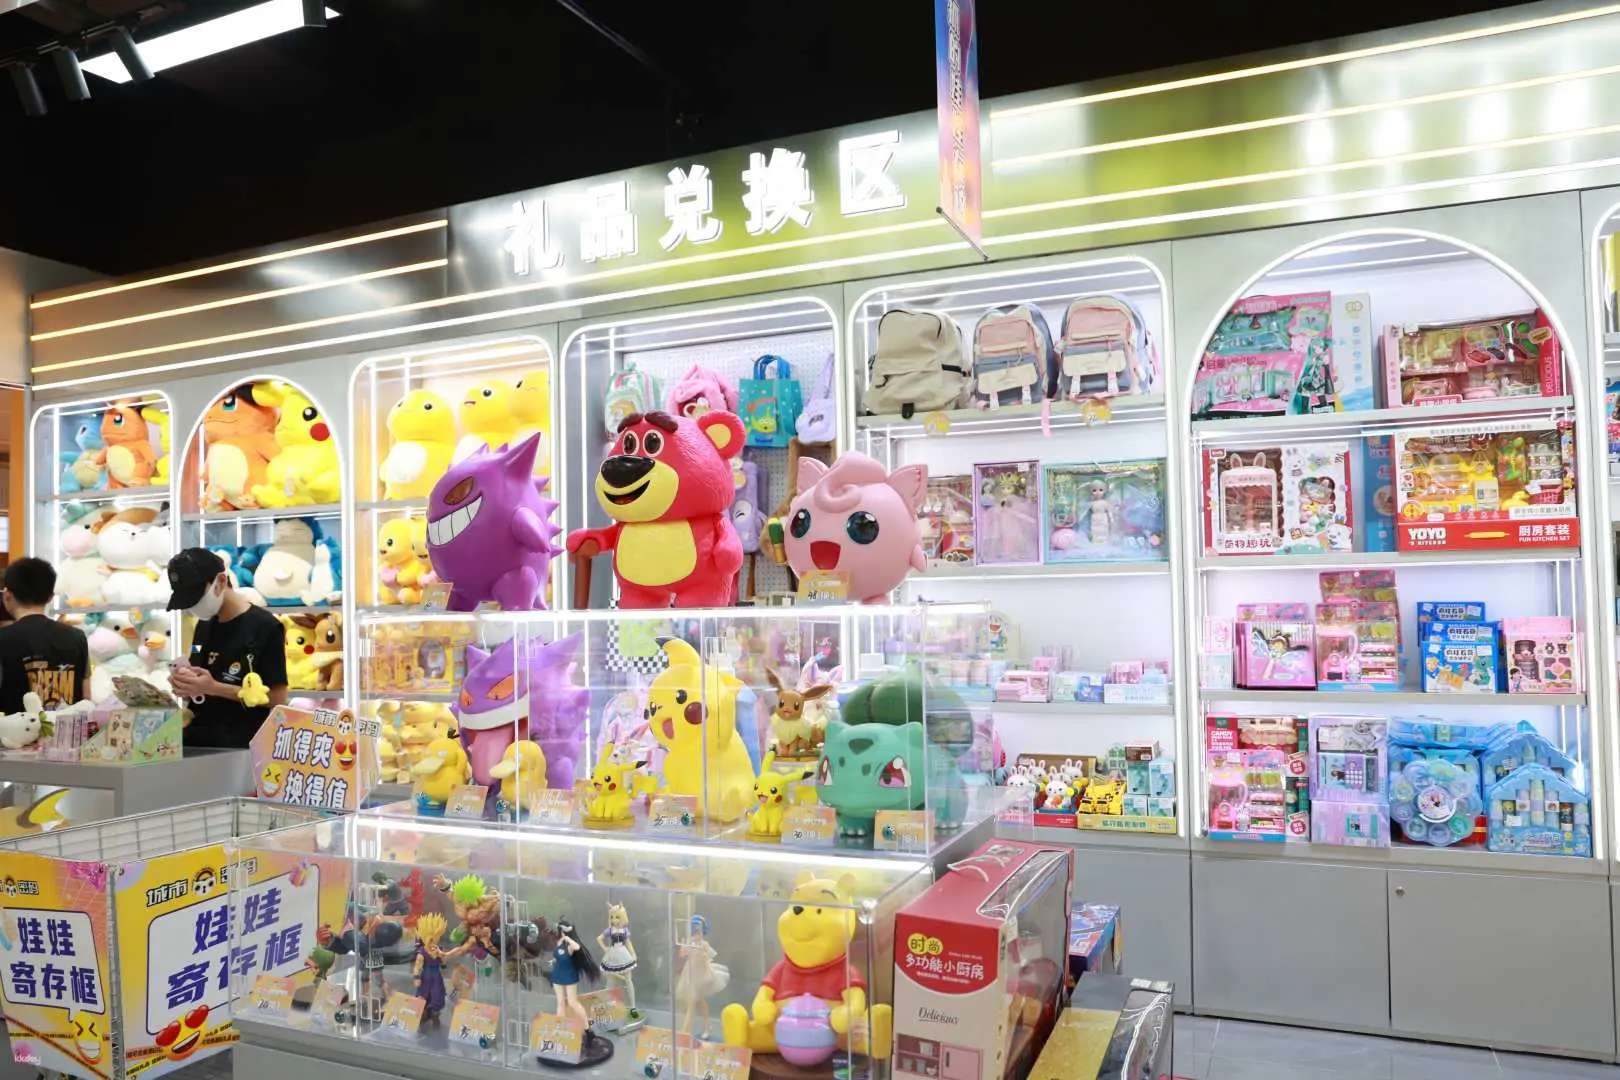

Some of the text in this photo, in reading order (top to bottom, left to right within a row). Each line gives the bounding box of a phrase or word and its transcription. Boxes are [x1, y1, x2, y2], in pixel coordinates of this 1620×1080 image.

[503, 130, 907, 277] 礼品兑换区
[1408, 528, 1446, 540] YOYO
[1519, 524, 1570, 537] 厨房套装
[272, 724, 334, 769] 抓得爽
[284, 769, 348, 808] 换得值
[17, 916, 76, 957] 娃娃
[191, 887, 282, 955] 娃娃
[910, 937, 941, 953] 时尚
[10, 961, 99, 1005] 寄存框
[166, 923, 303, 1010] 寄存框
[905, 953, 984, 980] 多功能小厨房
[918, 1007, 959, 1024] Delicious
